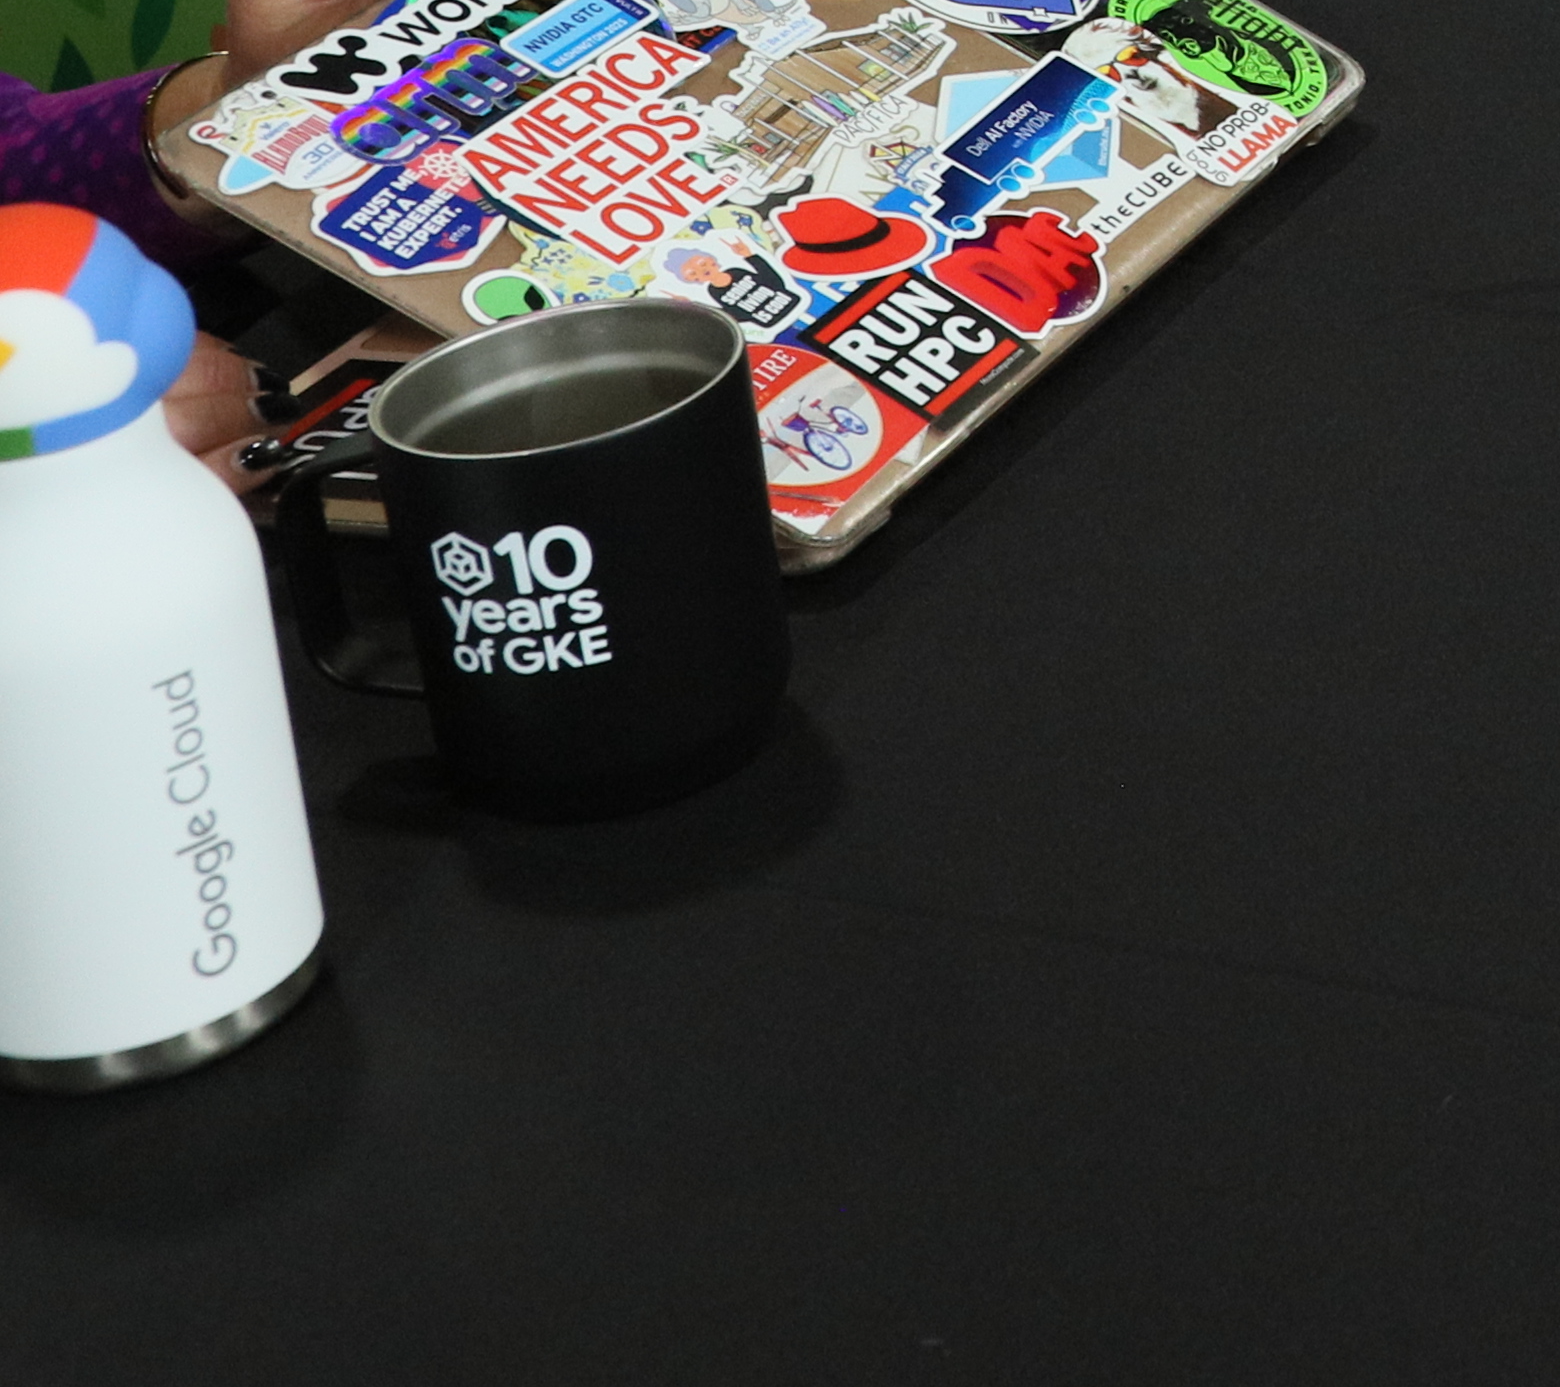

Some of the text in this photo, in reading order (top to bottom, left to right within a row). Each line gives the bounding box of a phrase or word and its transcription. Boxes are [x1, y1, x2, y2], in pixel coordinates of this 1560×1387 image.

[523, 2, 604, 56] NVIDIA GTC
[551, 28, 610, 68] WASHINGTON
[337, 39, 538, 164] arm
[460, 35, 703, 194] AMERICA
[833, 94, 910, 143] PACIFICA
[965, 133, 990, 158] Dell
[997, 98, 1038, 136] Factory
[1018, 107, 1054, 141] NVIDIA
[1196, 101, 1271, 157] NO PROB-
[301, 141, 334, 165] 30
[511, 103, 702, 229] NEEDS
[1217, 114, 1299, 173] LLAMA
[341, 168, 427, 233] TRUST ME,
[358, 195, 419, 243] I AM A
[597, 158, 723, 265] LOVE
[393, 206, 464, 260] EXPERT.
[720, 274, 757, 307] senior
[737, 284, 775, 313] living
[751, 290, 793, 325] is cool
[828, 278, 956, 374] RUN
[878, 314, 997, 407] HPC
[493, 524, 593, 596] 10
[441, 588, 604, 643] years
[453, 625, 613, 675] of GKE
[150, 668, 238, 978] Google Cloud
